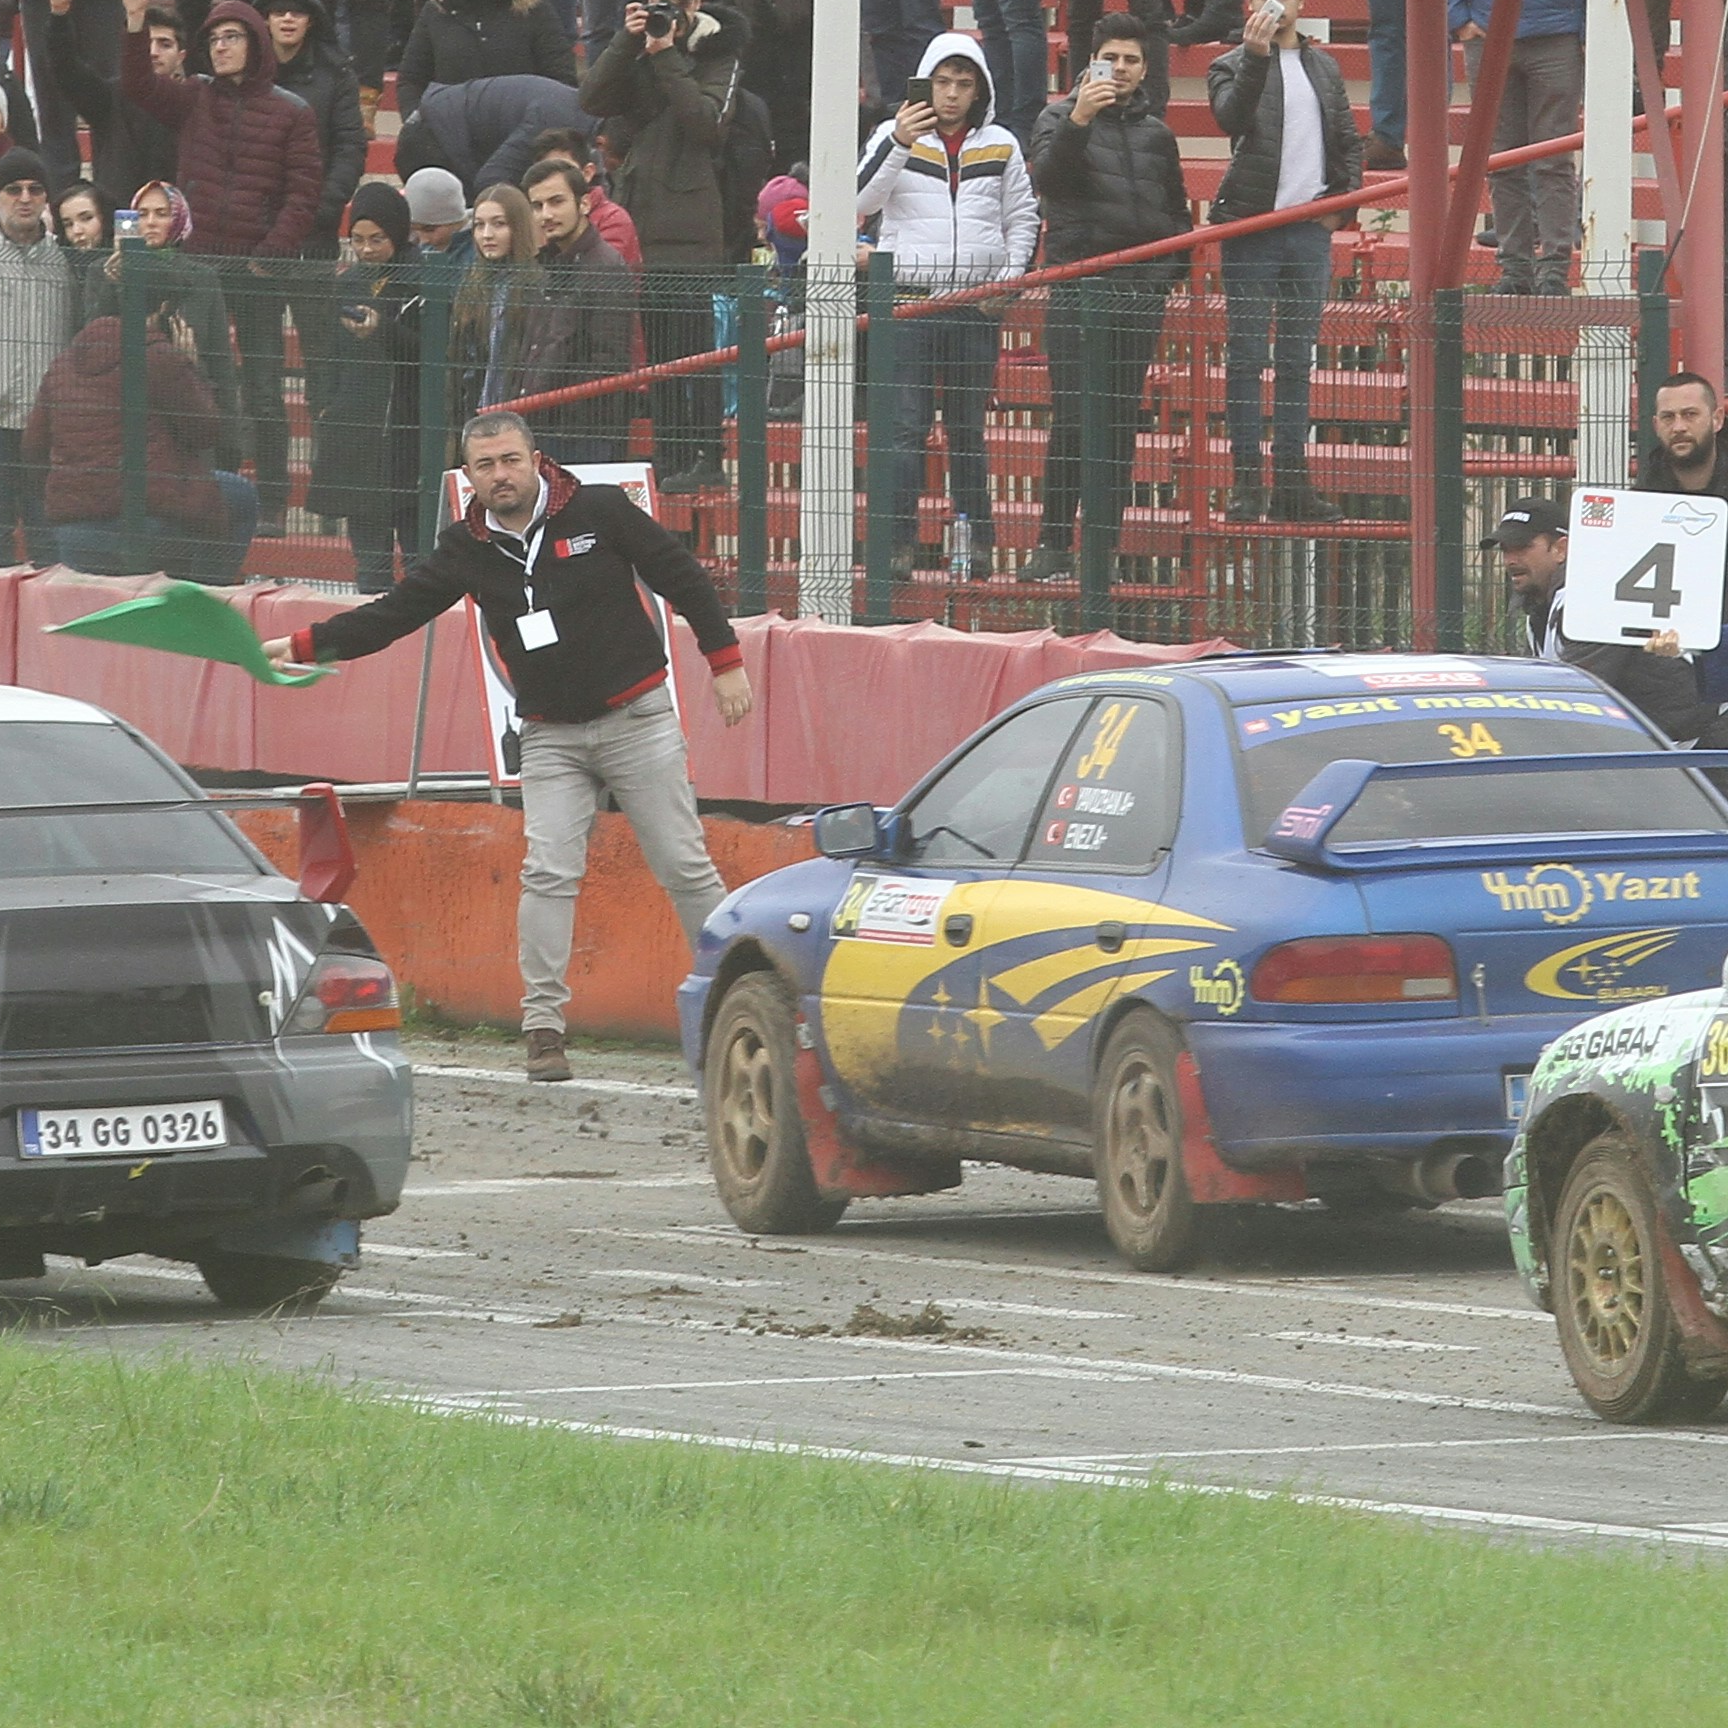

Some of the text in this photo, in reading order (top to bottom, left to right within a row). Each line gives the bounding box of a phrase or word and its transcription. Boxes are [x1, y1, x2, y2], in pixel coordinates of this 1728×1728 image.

[1614, 542, 1682, 618] 4
[1414, 693, 1607, 717] makina
[1077, 703, 1140, 780] 34
[1438, 722, 1504, 758] 34
[834, 882, 875, 931] 34
[1596, 984, 1669, 1000] SUBARU
[44, 1111, 218, 1149] 34 GG 0326
